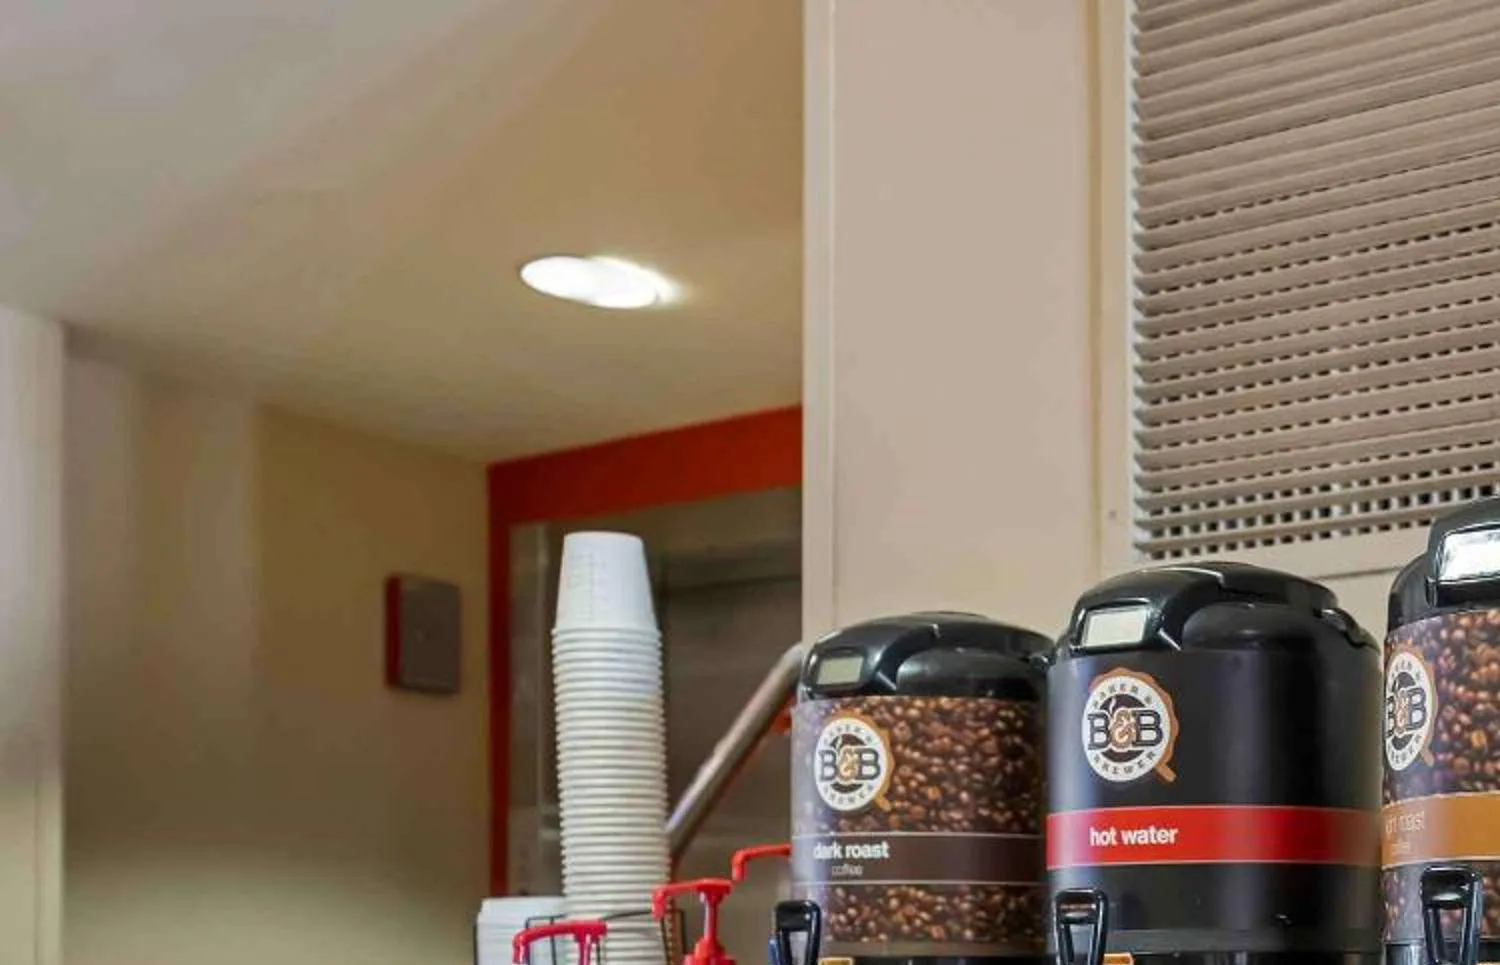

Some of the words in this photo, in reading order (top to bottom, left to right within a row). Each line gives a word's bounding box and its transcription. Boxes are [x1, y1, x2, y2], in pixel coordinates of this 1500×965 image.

[1089, 826, 1118, 846] hot
[1120, 825, 1179, 846] water
[814, 841, 843, 860] dark
[845, 841, 889, 859] roast
